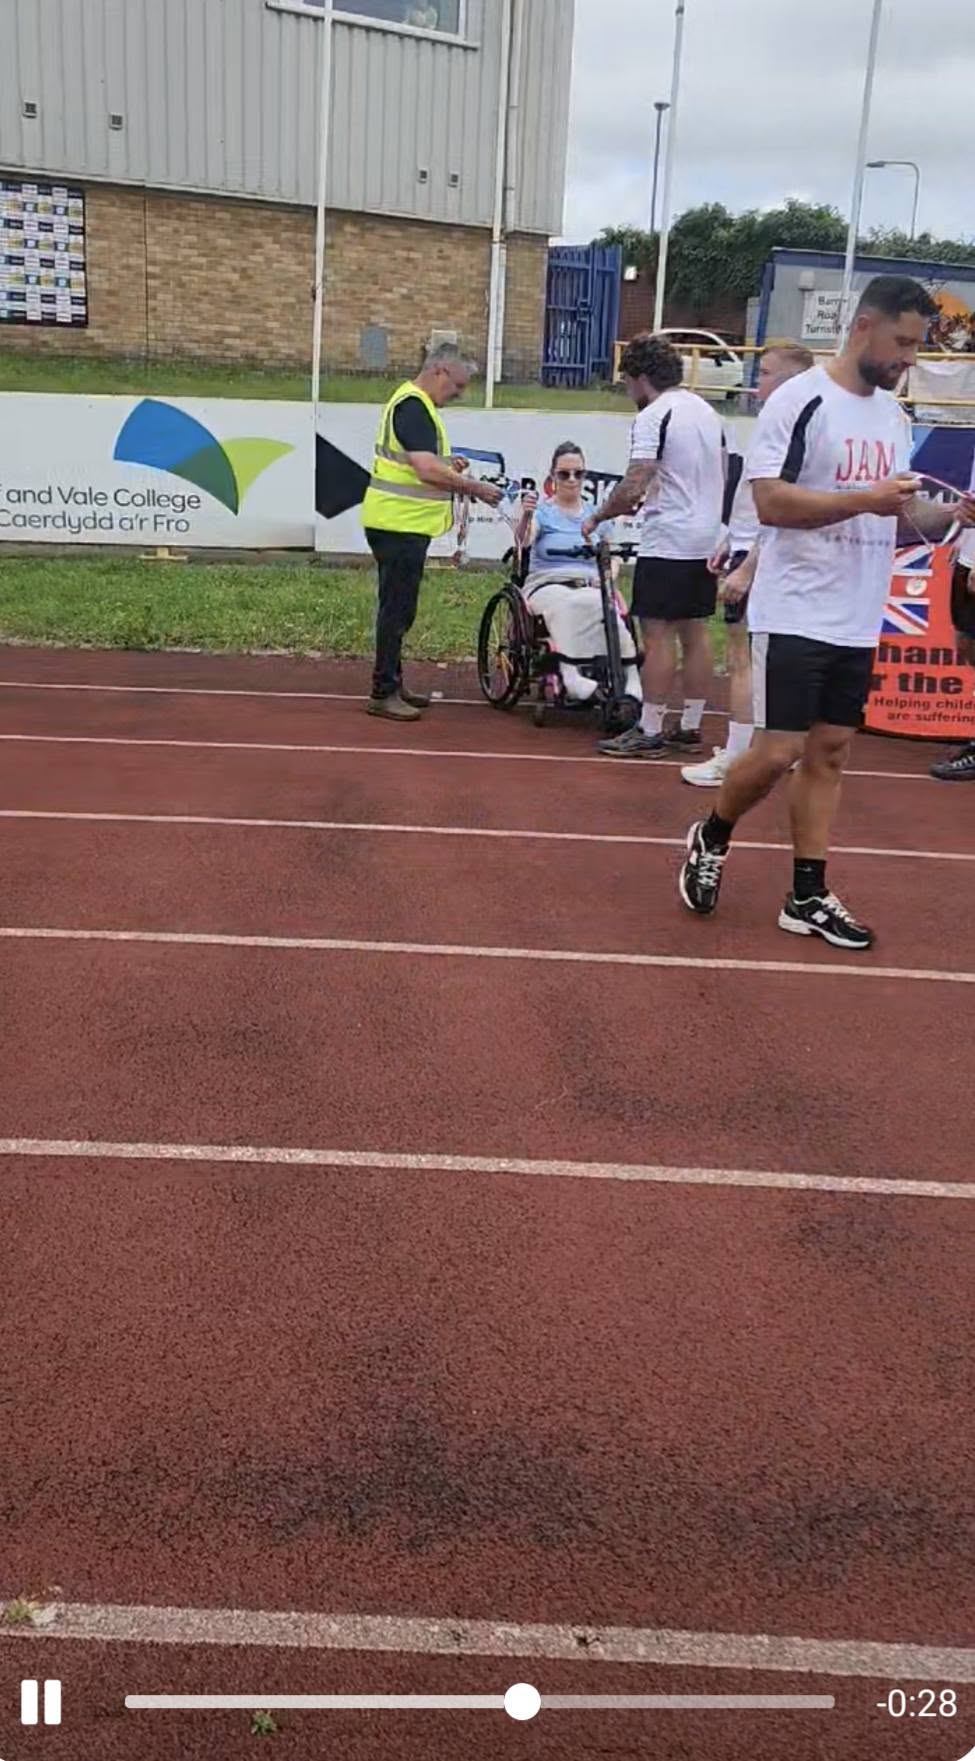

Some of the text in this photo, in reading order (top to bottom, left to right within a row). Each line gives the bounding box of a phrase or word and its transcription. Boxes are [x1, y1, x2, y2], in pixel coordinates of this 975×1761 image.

[836, 438, 897, 481] JAM
[6, 486, 201, 513] and Vale College
[0, 509, 190, 534] Caerdydd a'r Fro
[878, 642, 966, 666] han
[898, 672, 964, 694] the
[874, 697, 975, 710] Helping child
[887, 712, 910, 721] are
